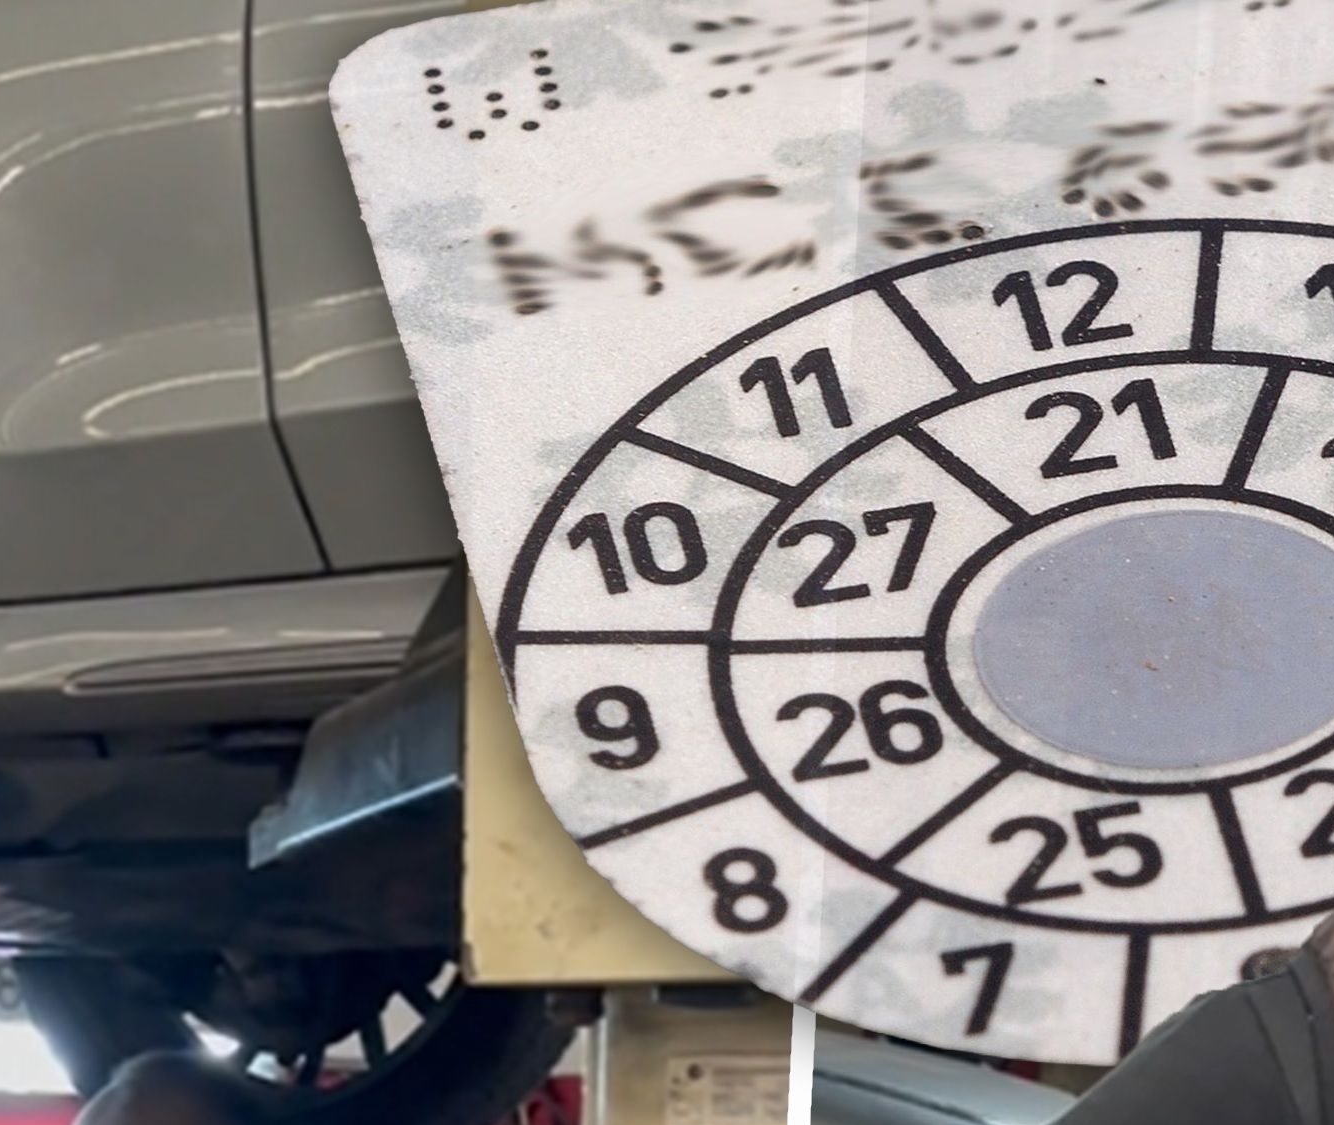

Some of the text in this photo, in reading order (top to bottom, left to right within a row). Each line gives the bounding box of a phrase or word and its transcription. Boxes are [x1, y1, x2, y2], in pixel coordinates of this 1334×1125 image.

[992, 260, 1133, 352] 12
[740, 347, 852, 438] 11
[1025, 379, 1177, 480] 21
[567, 501, 707, 595] 10
[778, 501, 937, 608] 27
[576, 685, 660, 771] 9
[777, 680, 943, 783] 26
[704, 847, 788, 934] 8
[990, 802, 1163, 905] 25
[941, 942, 1015, 1036] 7
